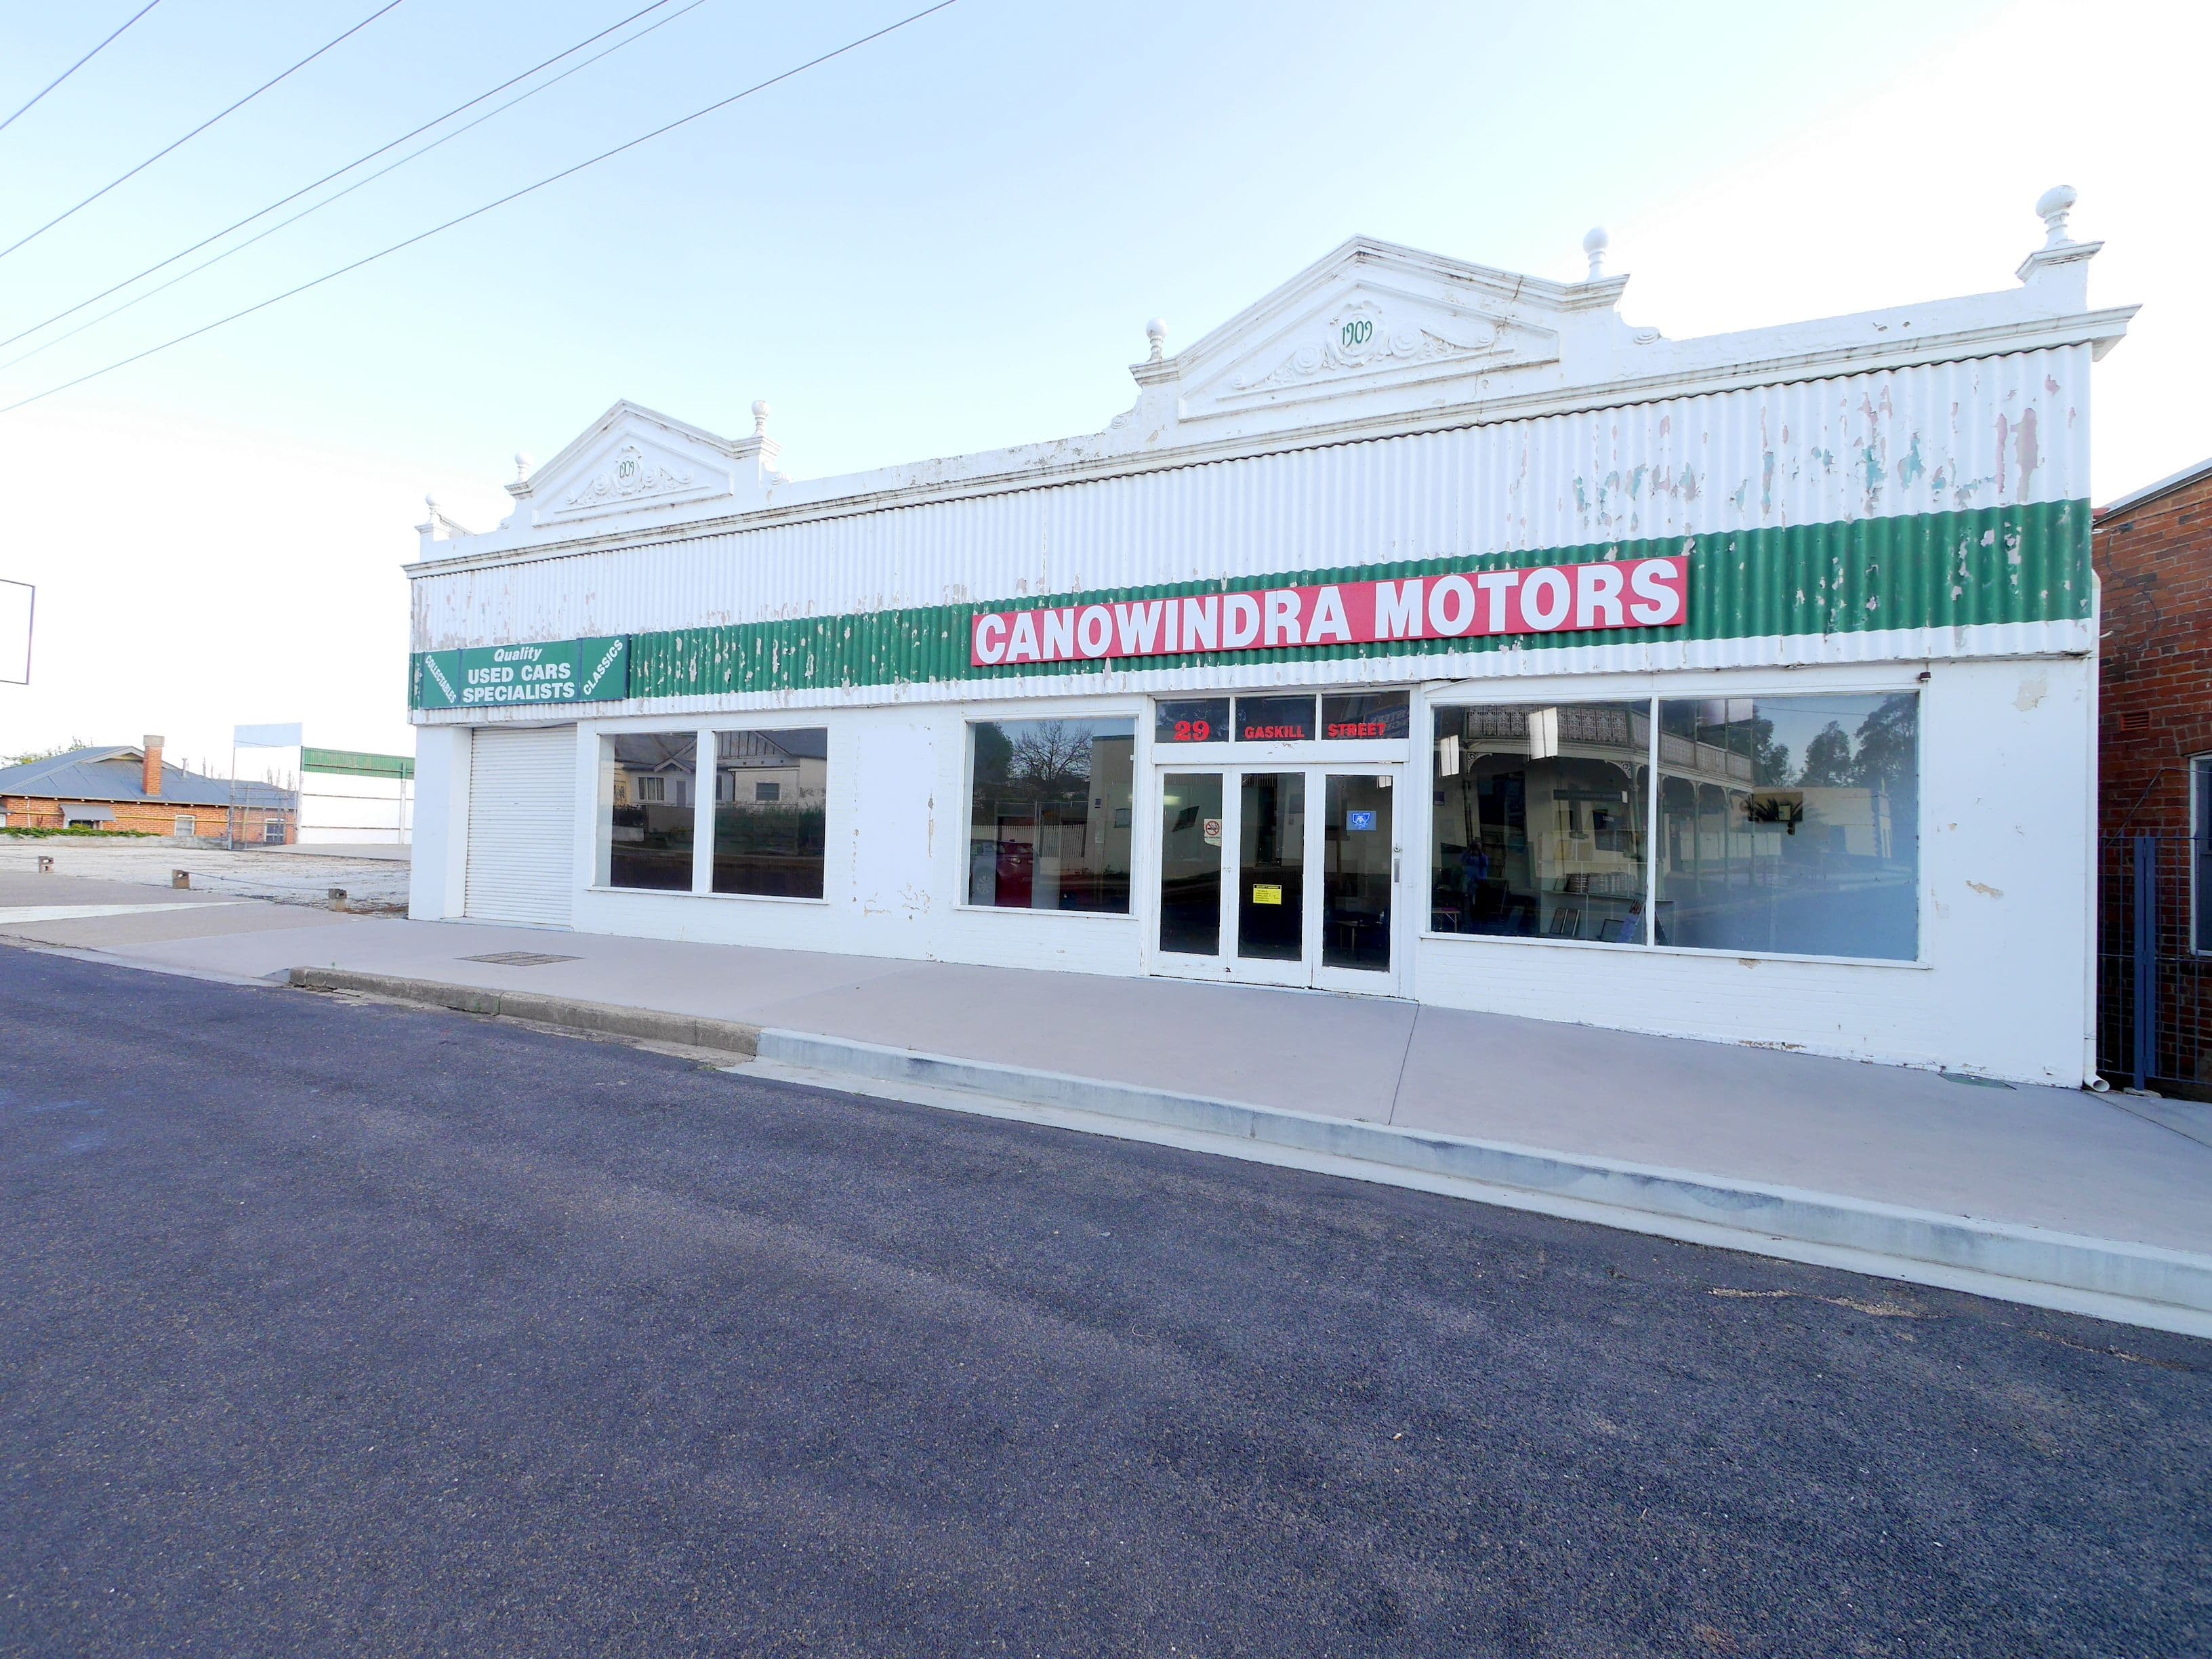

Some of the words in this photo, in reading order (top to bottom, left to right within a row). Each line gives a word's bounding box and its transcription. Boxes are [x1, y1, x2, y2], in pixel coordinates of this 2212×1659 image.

[1342, 321, 1372, 348] 1909
[975, 588, 1351, 664] CANOWINDRA
[1374, 558, 1681, 639] MOTORS
[494, 647, 542, 662] Quality
[425, 655, 457, 703] COLLECTABLES
[468, 668, 514, 684] USED
[521, 663, 571, 681] CARS
[583, 639, 623, 696] CLASSICS
[463, 682, 575, 703] SPECIALISTS
[1174, 720, 1210, 741] 29
[1244, 725, 1305, 739] GASKILL
[1328, 722, 1386, 737] STREET
